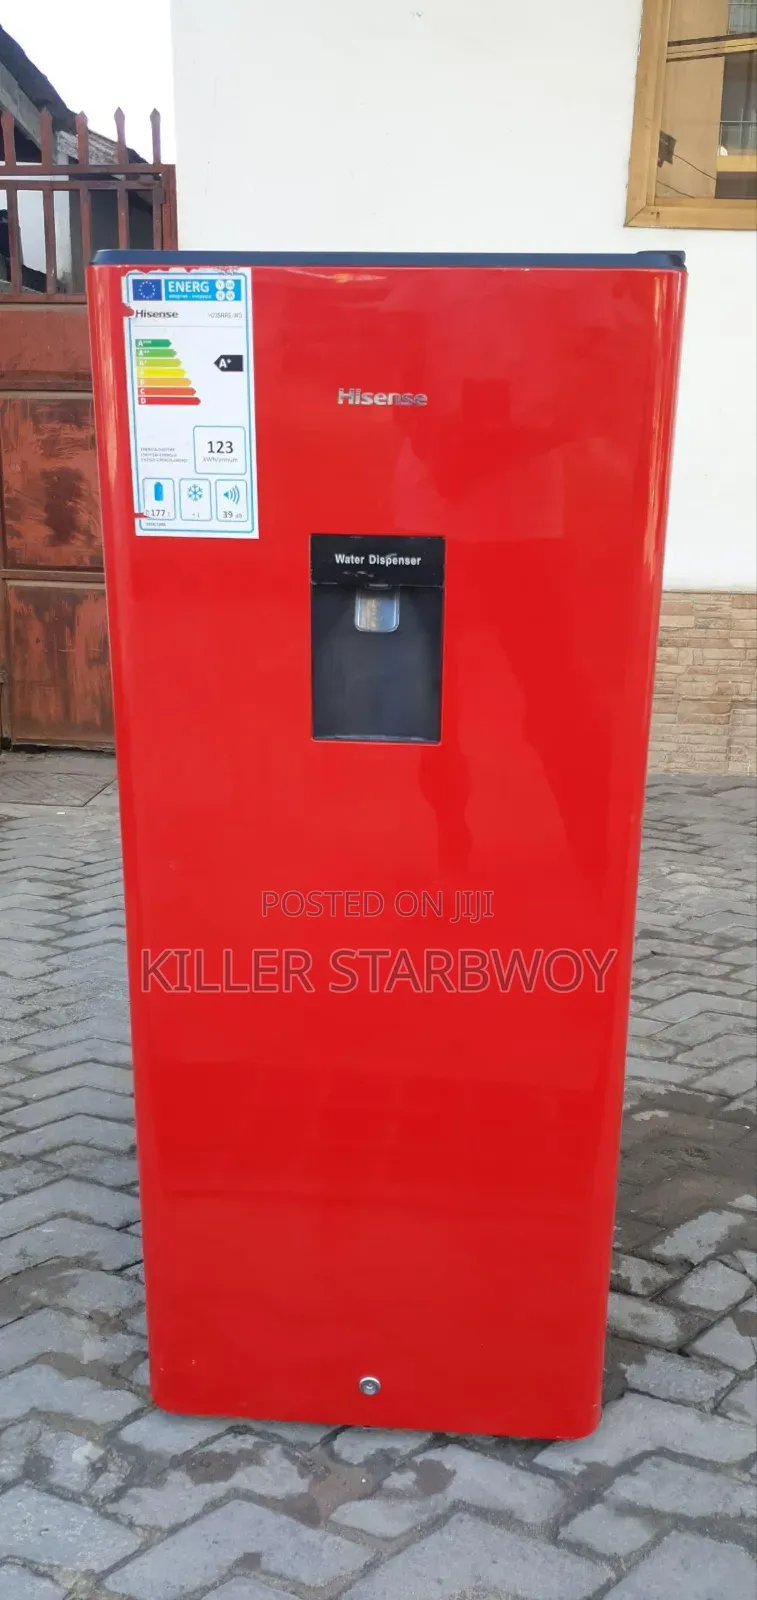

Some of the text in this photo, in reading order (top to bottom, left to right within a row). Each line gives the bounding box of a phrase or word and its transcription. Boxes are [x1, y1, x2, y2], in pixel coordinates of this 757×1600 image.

[168, 281, 210, 293] ENERG
[135, 309, 179, 319] Hisense
[219, 358, 232, 369] A+
[337, 388, 428, 407] Hisense
[207, 440, 234, 454] 123
[151, 509, 166, 517] 177
[222, 510, 234, 519] 39
[334, 553, 422, 567] Water Dispenser
